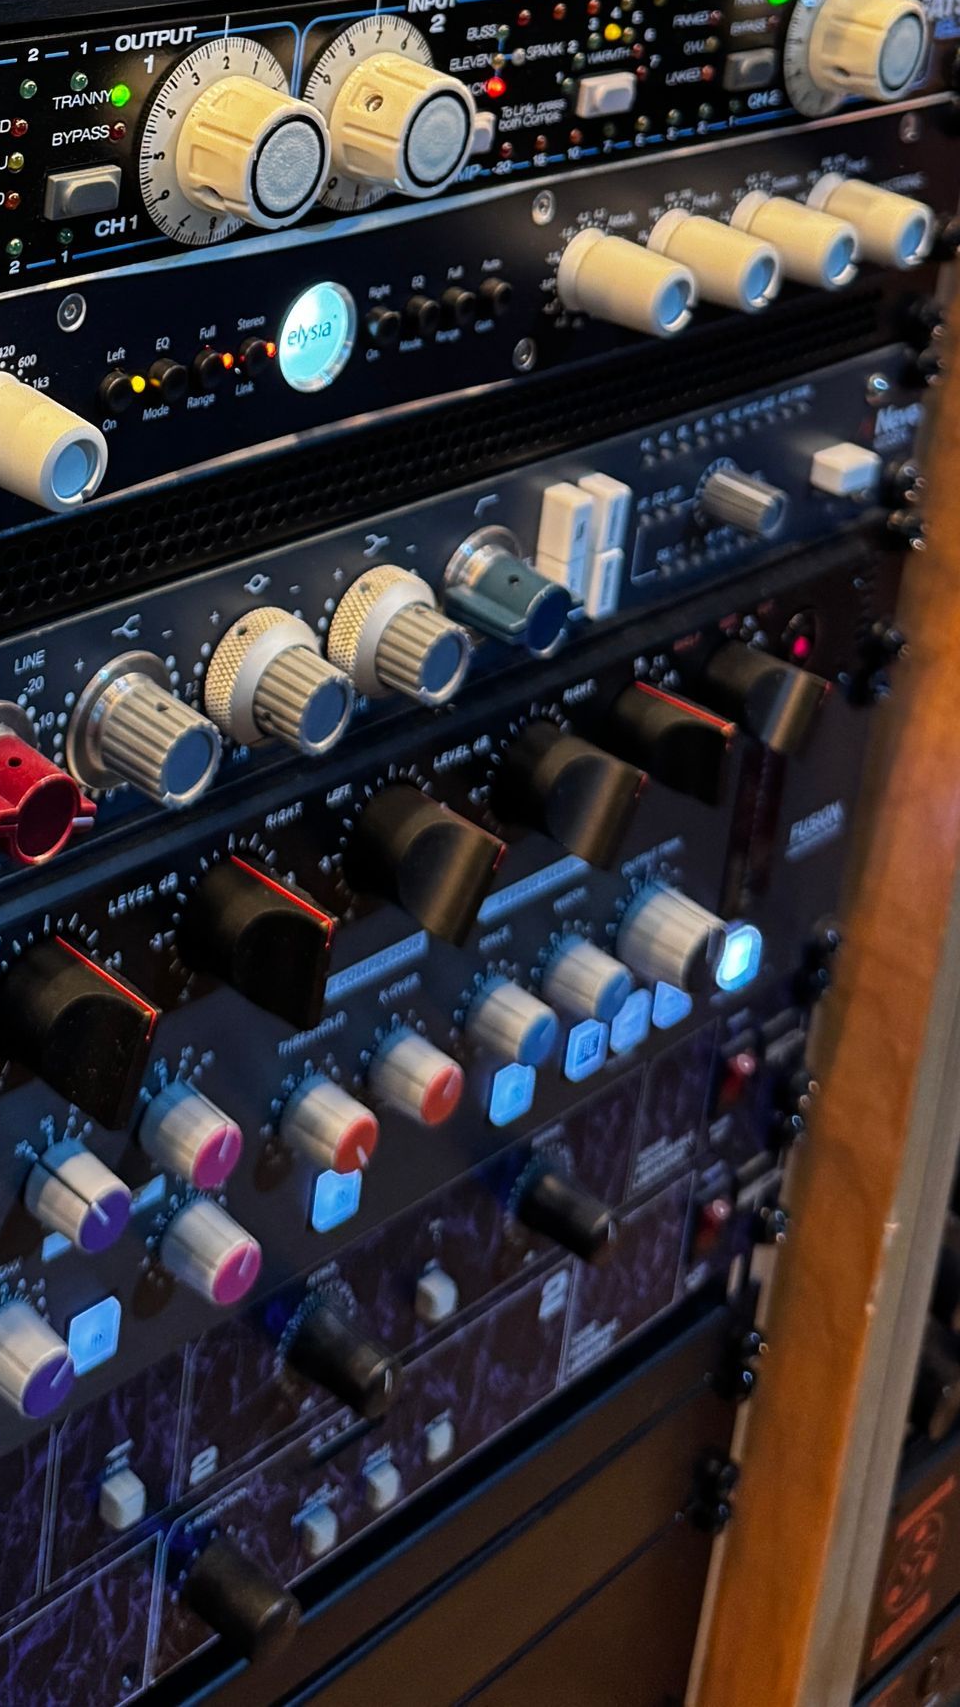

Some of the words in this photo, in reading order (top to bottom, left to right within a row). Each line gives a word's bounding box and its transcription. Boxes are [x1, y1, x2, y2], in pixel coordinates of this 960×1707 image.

[115, 26, 197, 53] OUTPUT
[52, 89, 112, 111] TRANNY
[52, 125, 109, 147] BYPASS
[94, 219, 126, 237] CH
[129, 215, 138, 230] 1
[237, 314, 265, 330] Stereo
[199, 325, 216, 340] Full
[287, 322, 331, 347] elysia
[155, 337, 170, 351] EQ
[18, 354, 37, 367] 600
[107, 347, 125, 362] Left
[235, 381, 254, 395] Link
[187, 392, 215, 409] Range
[142, 403, 169, 421] Mode
[102, 418, 117, 431] On
[14, 650, 45, 674] LINE
